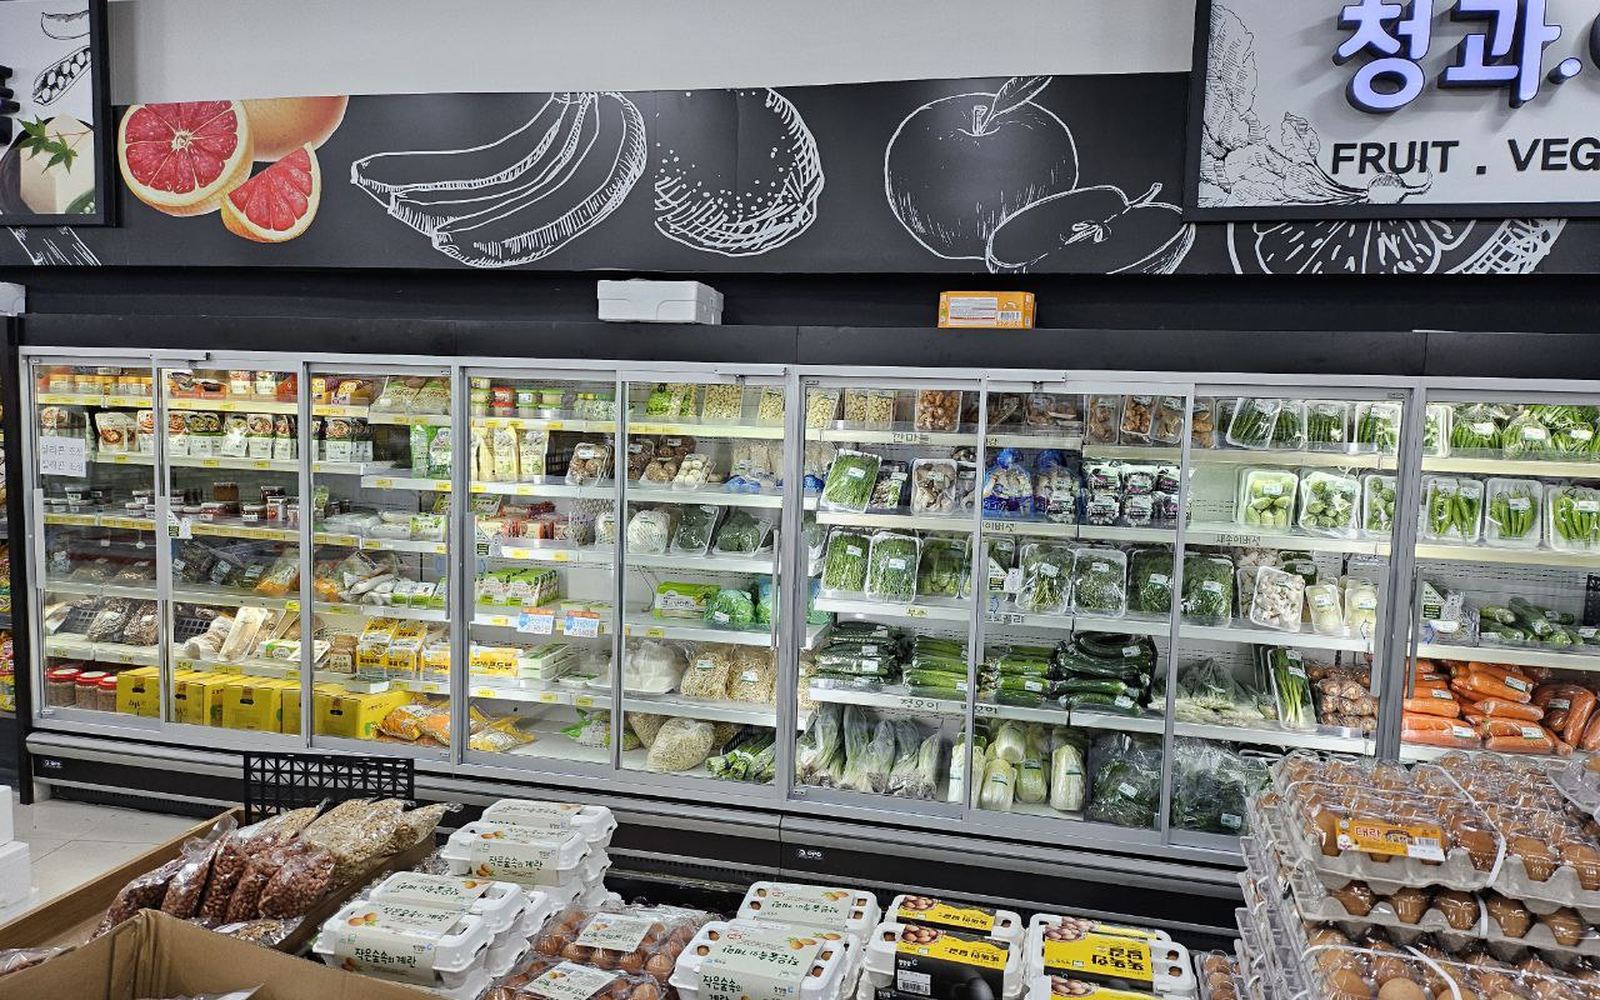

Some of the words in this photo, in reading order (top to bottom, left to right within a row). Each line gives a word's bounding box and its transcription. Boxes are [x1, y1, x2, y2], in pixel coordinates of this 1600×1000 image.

[1332, 140, 1459, 175] FRUIT
[984, 521, 1015, 532] 이버섯
[1216, 534, 1261, 546] 새송이버섯
[525, 860, 544, 870] 계란
[722, 944, 747, 956] 계란
[354, 948, 395, 965] 작은숲속의
[396, 955, 417, 969] 계란
[703, 974, 743, 992] 작은숲속의
